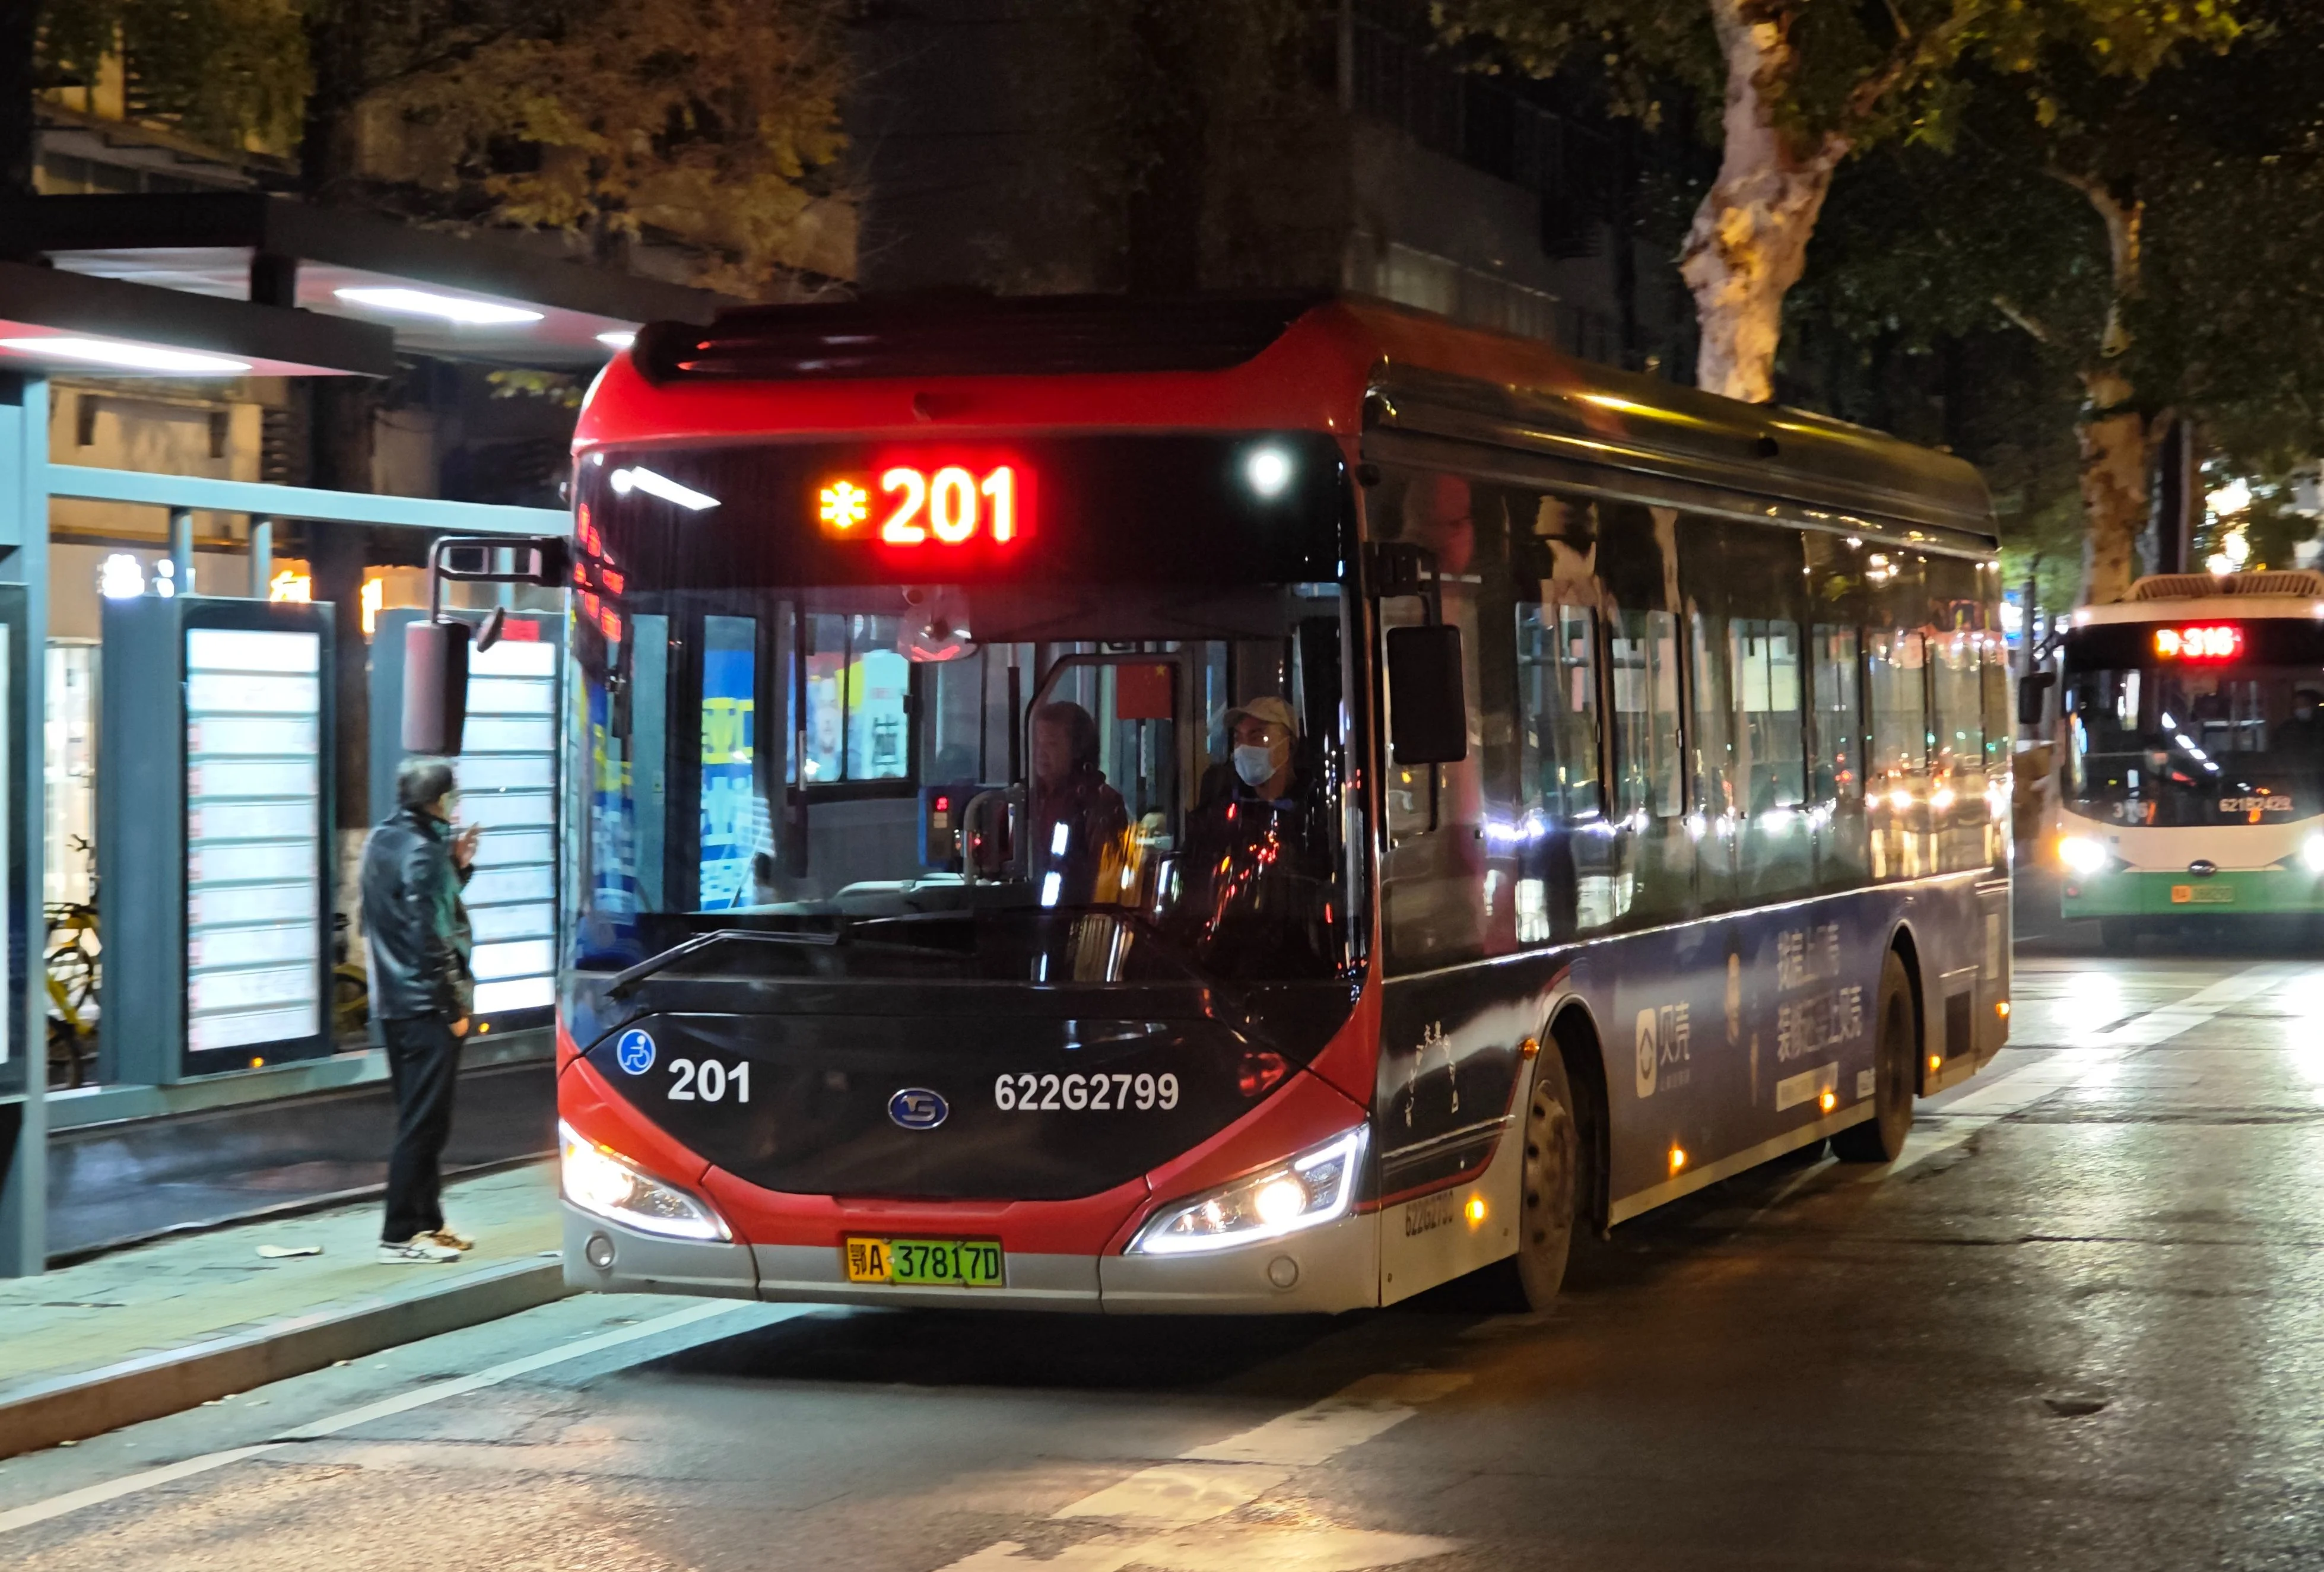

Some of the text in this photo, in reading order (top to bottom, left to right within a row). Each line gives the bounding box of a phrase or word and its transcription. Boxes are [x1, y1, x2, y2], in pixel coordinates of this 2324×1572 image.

[882, 466, 1013, 542] 201
[1660, 1000, 1691, 1067] 贝壳
[668, 1058, 750, 1103] 201
[995, 1073, 1179, 1110] 622G2799
[850, 1244, 999, 1279] 鄂A 37817D
